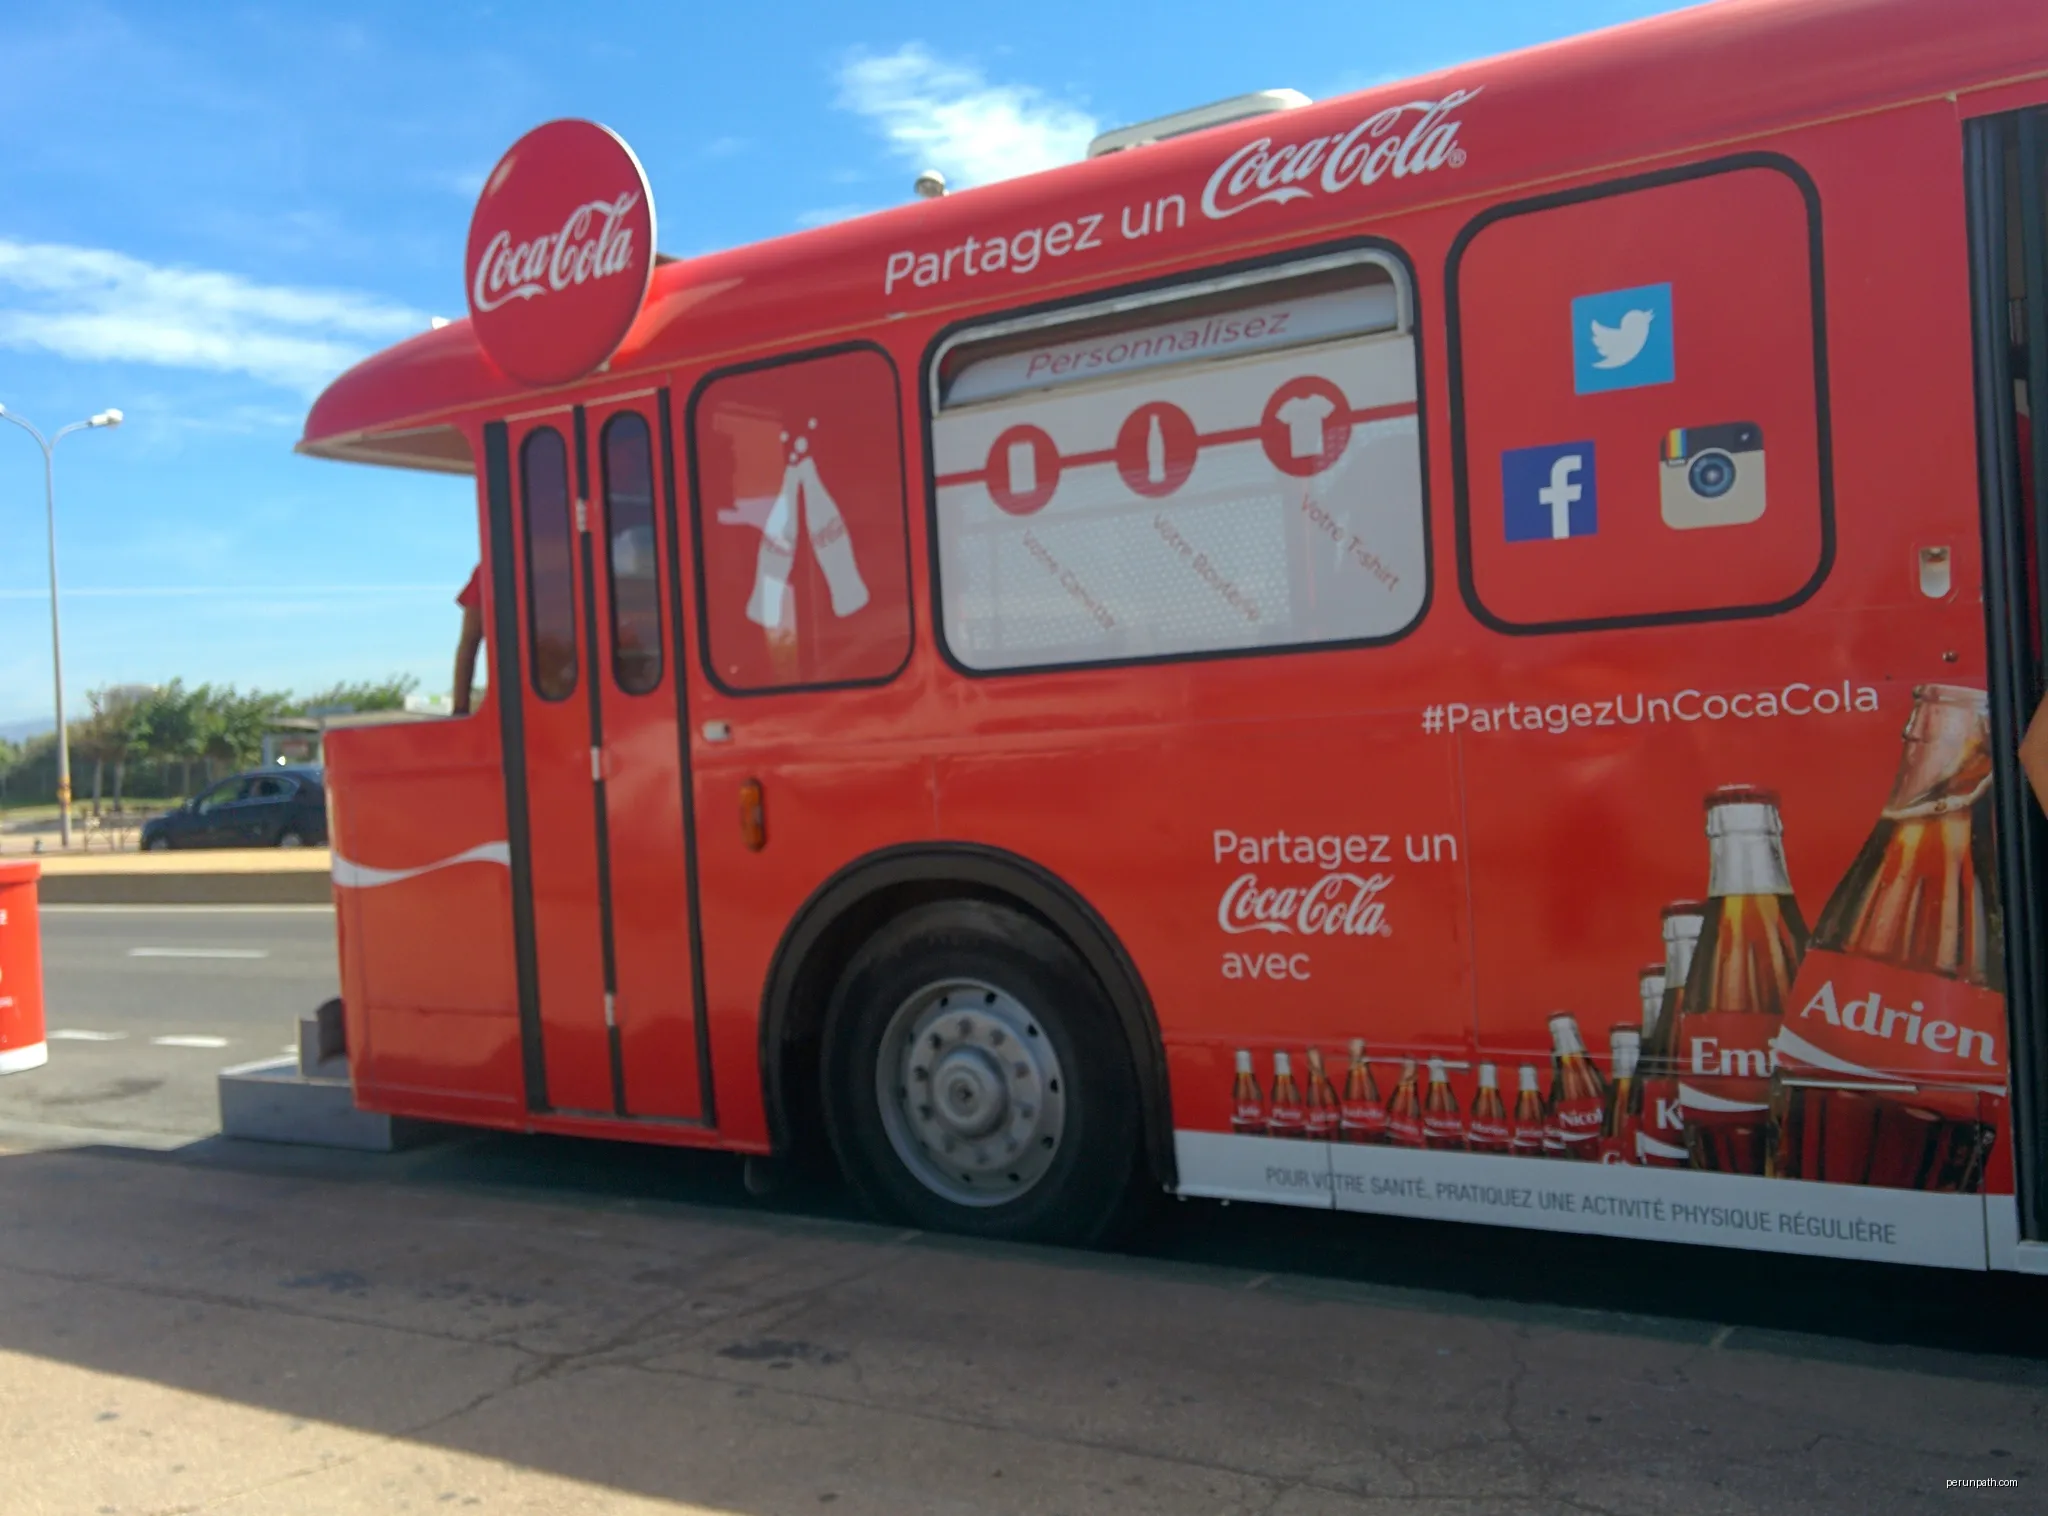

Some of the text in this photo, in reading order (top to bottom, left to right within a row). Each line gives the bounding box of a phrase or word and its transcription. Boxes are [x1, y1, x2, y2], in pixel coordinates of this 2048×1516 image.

[885, 212, 1102, 296] Partagez
[1121, 192, 1186, 240] un
[1026, 311, 1291, 379] Personnalisez
[1302, 492, 1345, 541] Votre
[1421, 680, 1880, 735] #PartagezUnCocaCola
[1213, 828, 1458, 870] Partagez un
[1221, 951, 1311, 980] avec
[1800, 980, 1998, 1067] Adrien
[1265, 1166, 1310, 1188] POUR
[1312, 1170, 1365, 1194] VOTRE
[1436, 1181, 1532, 1209] PRATIQUEZ
[1540, 1191, 1575, 1213] UNE
[1580, 1195, 1666, 1221] ACTIVITÉ
[1672, 1202, 1772, 1233] PHYSIQUE
[1779, 1210, 1897, 1245] RÉGULIÈRE
